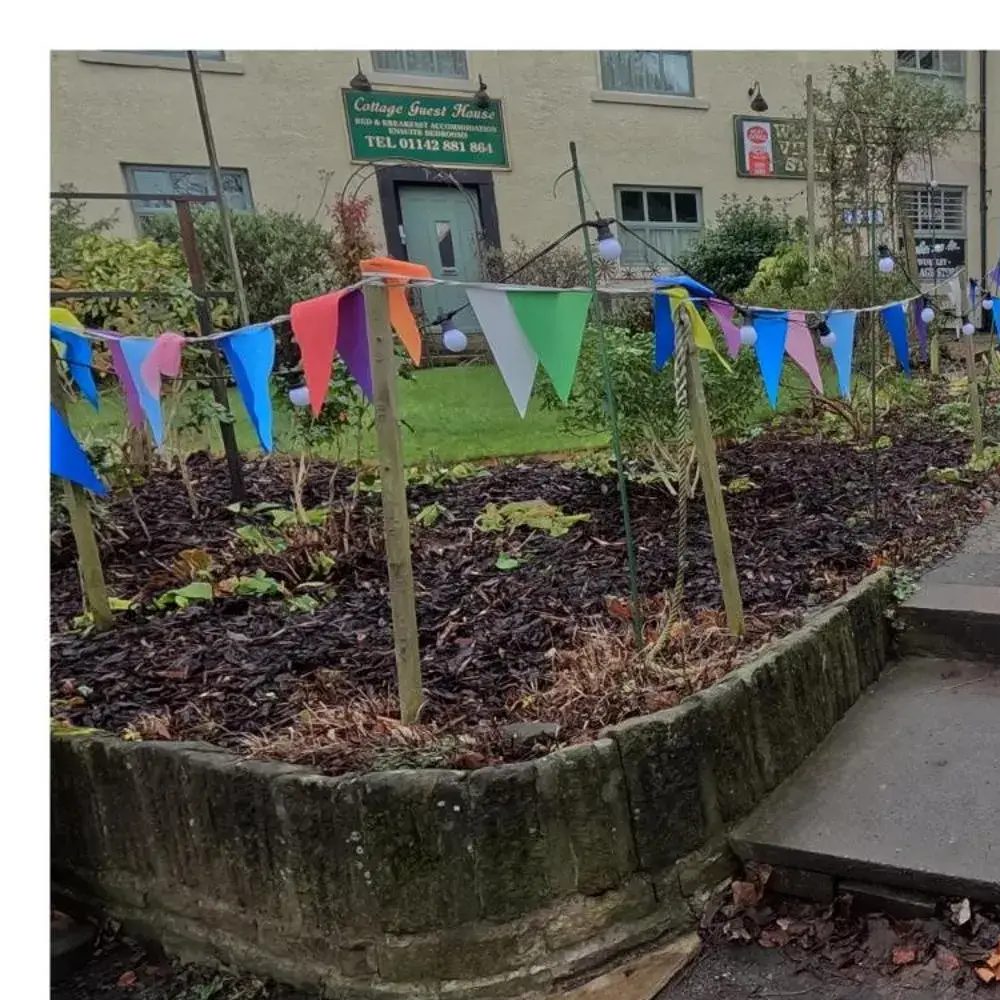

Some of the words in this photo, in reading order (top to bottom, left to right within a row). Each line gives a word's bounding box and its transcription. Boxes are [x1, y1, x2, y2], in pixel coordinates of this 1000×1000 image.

[354, 97, 402, 117] Cottage
[408, 100, 448, 117] Guest
[451, 104, 496, 120] House
[365, 135, 396, 149] TEL
[399, 138, 440, 151] 01142
[443, 140, 466, 152] 881
[470, 142, 494, 154] 864
